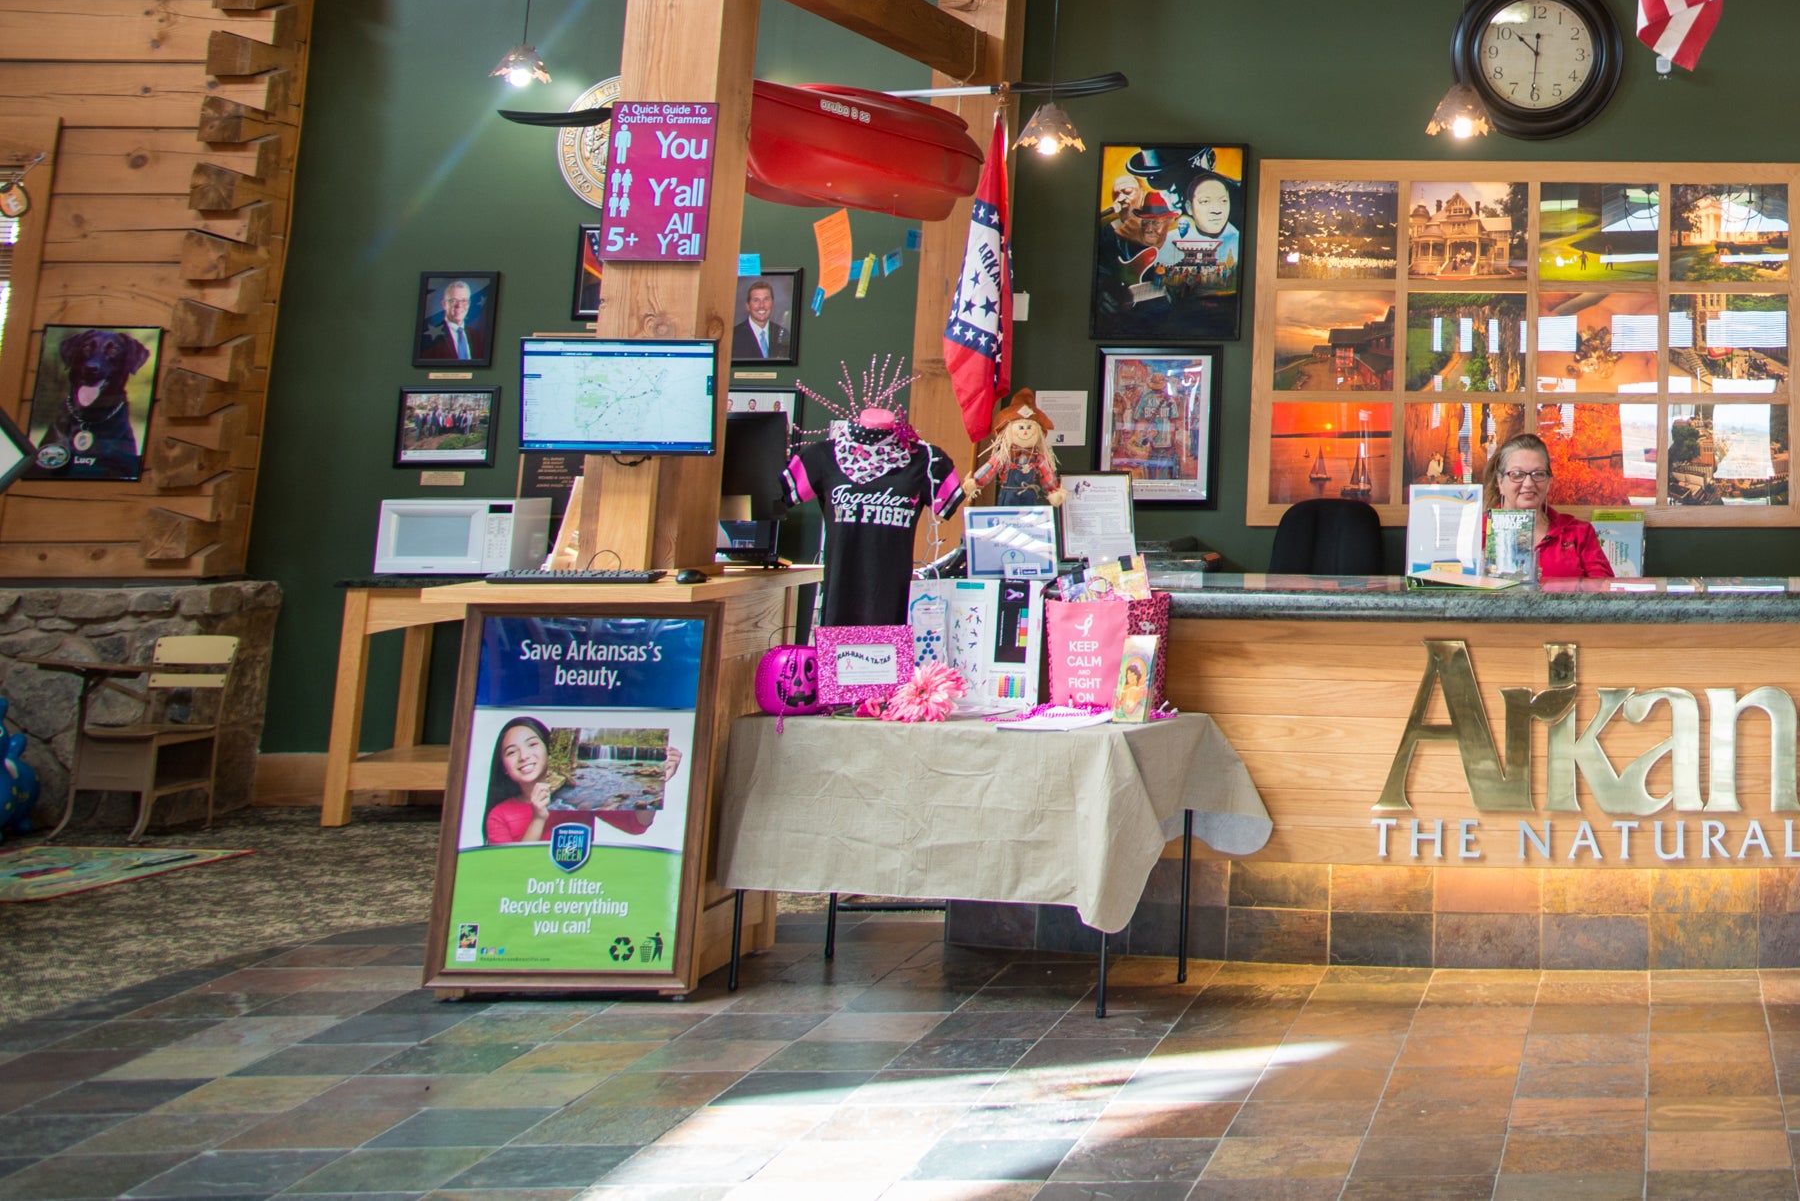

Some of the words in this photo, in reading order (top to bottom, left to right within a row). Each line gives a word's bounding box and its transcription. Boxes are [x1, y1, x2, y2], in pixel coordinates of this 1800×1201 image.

[1533, 6, 1547, 19] 12
[1558, 12, 1562, 25] 1
[1496, 27, 1512, 40] 10
[1571, 28, 1580, 40] 2
[1488, 46, 1499, 59] 9
[1575, 48, 1585, 61] 3
[1493, 67, 1504, 79] 8
[1568, 70, 1578, 82] 4
[1509, 82, 1519, 95] 7
[1530, 88, 1540, 102] 6
[1552, 84, 1562, 97] 5
[621, 105, 629, 114] A
[632, 105, 659, 114] Quick
[663, 105, 691, 115] Guide
[694, 105, 707, 114] To
[617, 114, 663, 124] Southern
[666, 115, 712, 124] Grammar
[656, 131, 709, 160] You
[565, 152, 591, 193] GREAT
[648, 178, 705, 207] Y'all
[664, 213, 694, 235] All
[606, 227, 639, 252] 5+
[656, 233, 701, 256] Y'all
[74, 454, 96, 466] Lucy
[831, 484, 910, 510] Together
[834, 506, 856, 522] WE
[861, 505, 915, 527] FIGHT
[1492, 514, 1529, 524] TRAVEL
[1492, 522, 1522, 530] GUIDE
[520, 639, 562, 661] Save
[566, 640, 662, 662] Arkansas's
[1069, 641, 1099, 652] KEEP
[1067, 656, 1102, 667] CALM
[554, 665, 621, 690] beauty.
[1068, 678, 1102, 689] FIGHT
[1076, 692, 1095, 703] ON
[558, 835, 584, 848] CLEAN
[1371, 818, 1481, 860] THE
[556, 848, 583, 861] GREEN
[527, 878, 564, 895] Don't
[568, 878, 604, 895] litter.
[500, 898, 550, 916] Recycle
[555, 899, 629, 917] everything
[534, 921, 558, 936] you
[563, 918, 592, 934] can!
